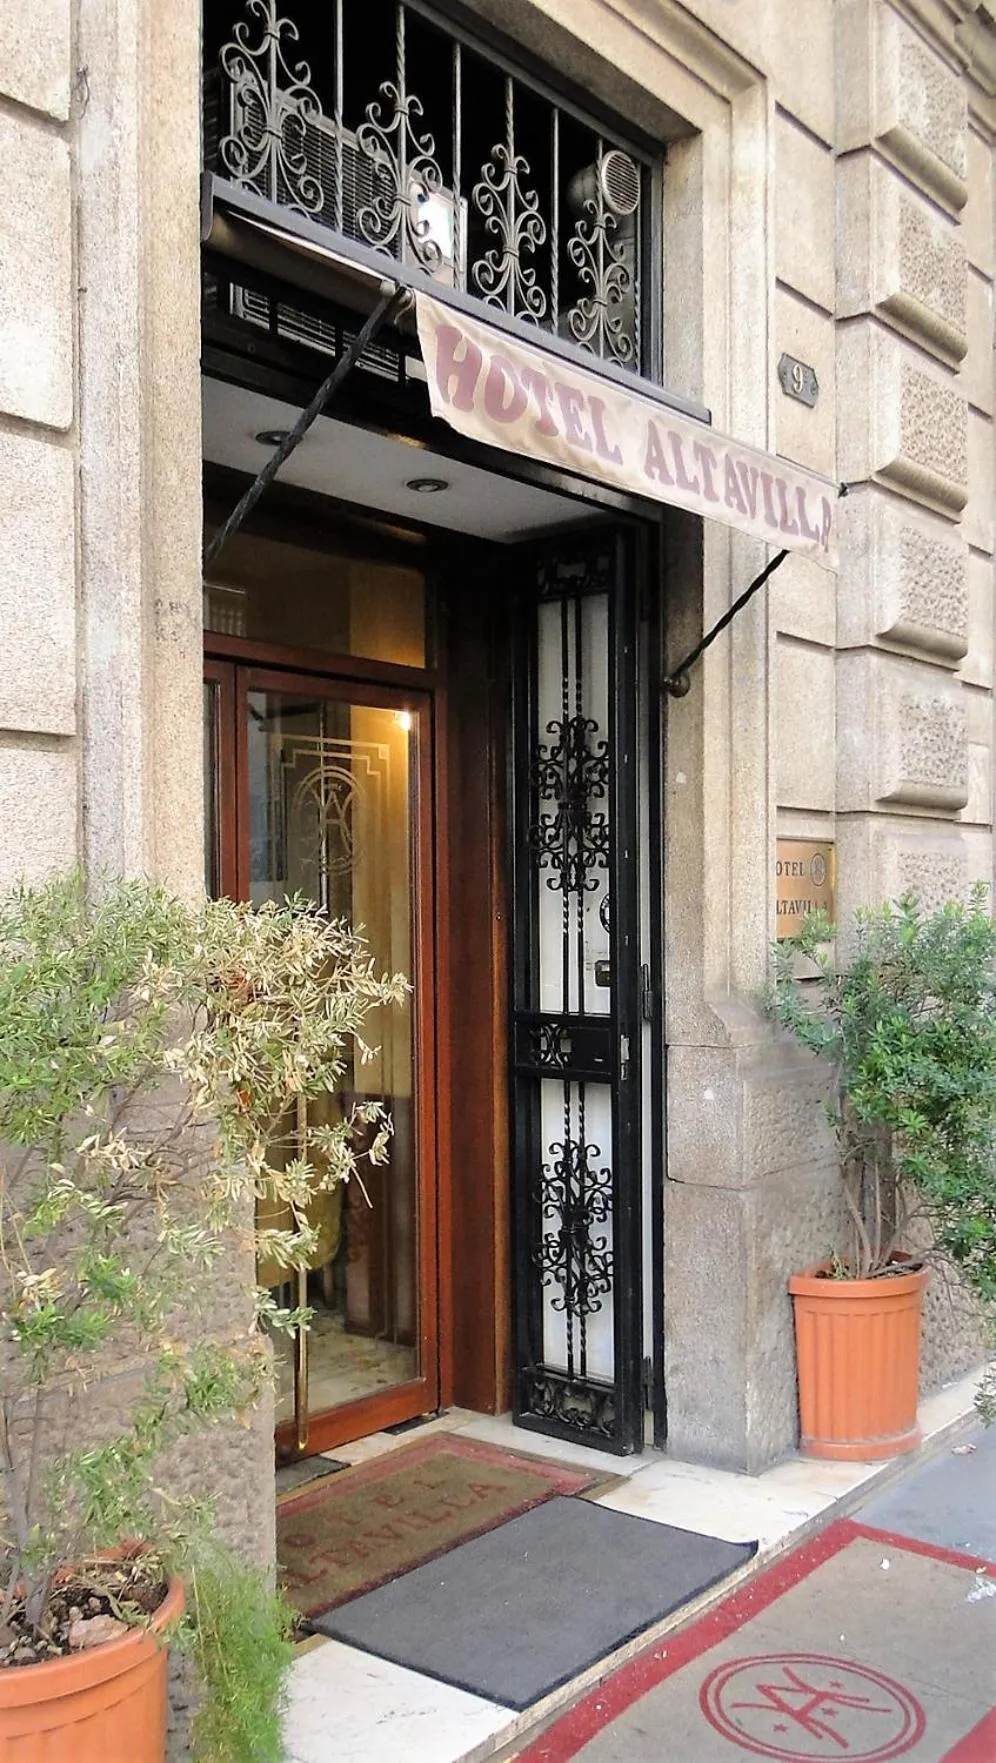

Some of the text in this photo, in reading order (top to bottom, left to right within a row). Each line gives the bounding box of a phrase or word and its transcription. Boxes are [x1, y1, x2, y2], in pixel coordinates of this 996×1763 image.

[792, 363, 804, 393] 9
[434, 324, 833, 553] HOTEL ALTAVILLA
[776, 861, 805, 876] OTEL
[279, 1481, 507, 1590] LTAVILLA
[283, 1477, 447, 1550] OTEL
